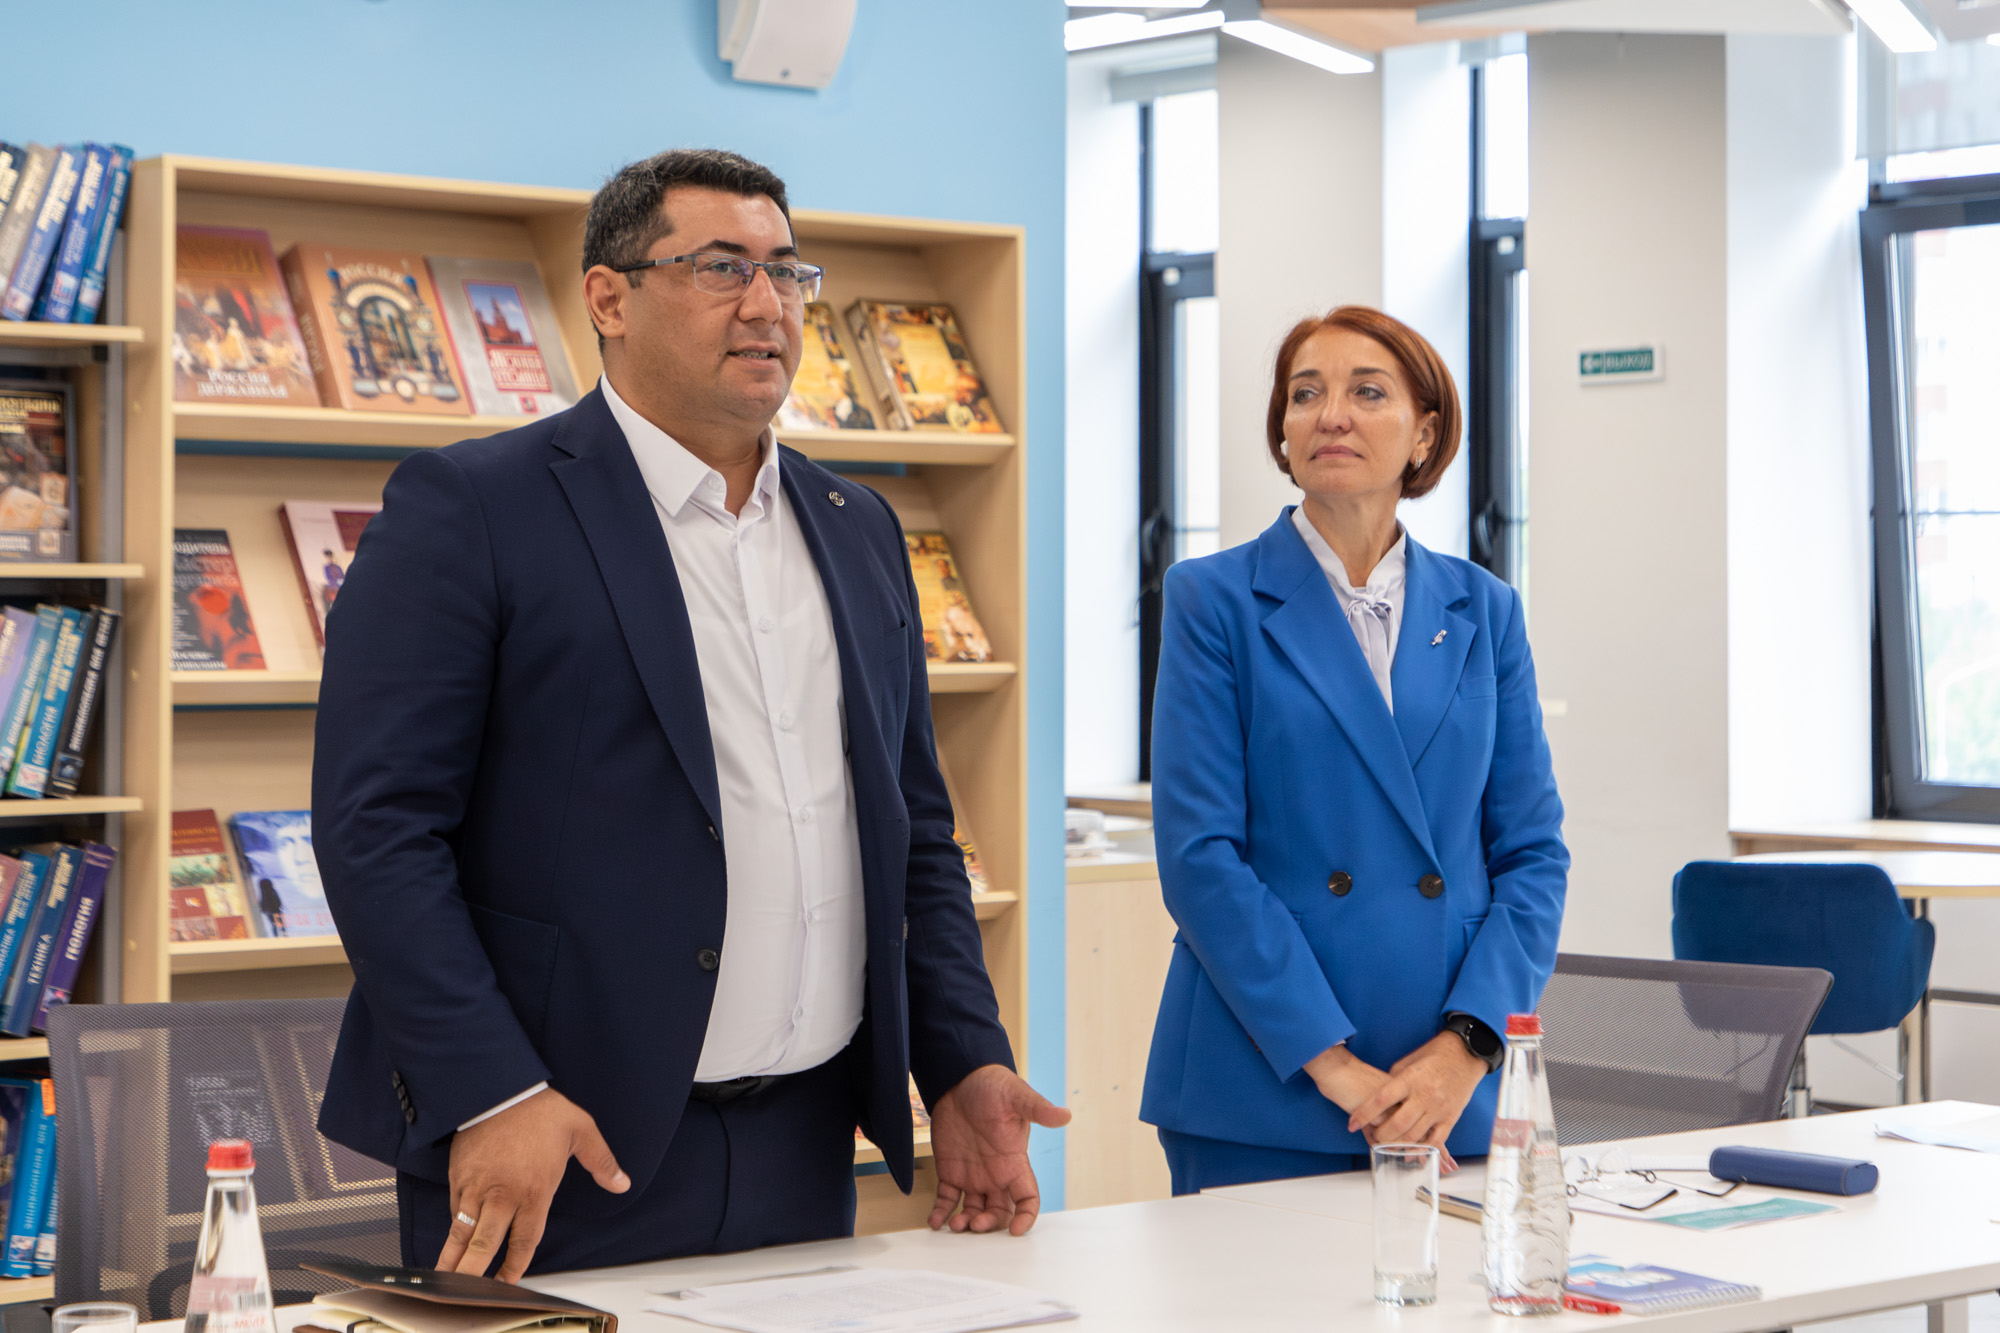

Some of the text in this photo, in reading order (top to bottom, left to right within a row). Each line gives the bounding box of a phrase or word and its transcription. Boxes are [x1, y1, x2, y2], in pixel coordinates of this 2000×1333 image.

[32, 706, 58, 765] БИОЛОГИЯ
[65, 897, 95, 961] ГЕОЛОГИЯ
[27, 934, 52, 985] ТЕХНИКА
